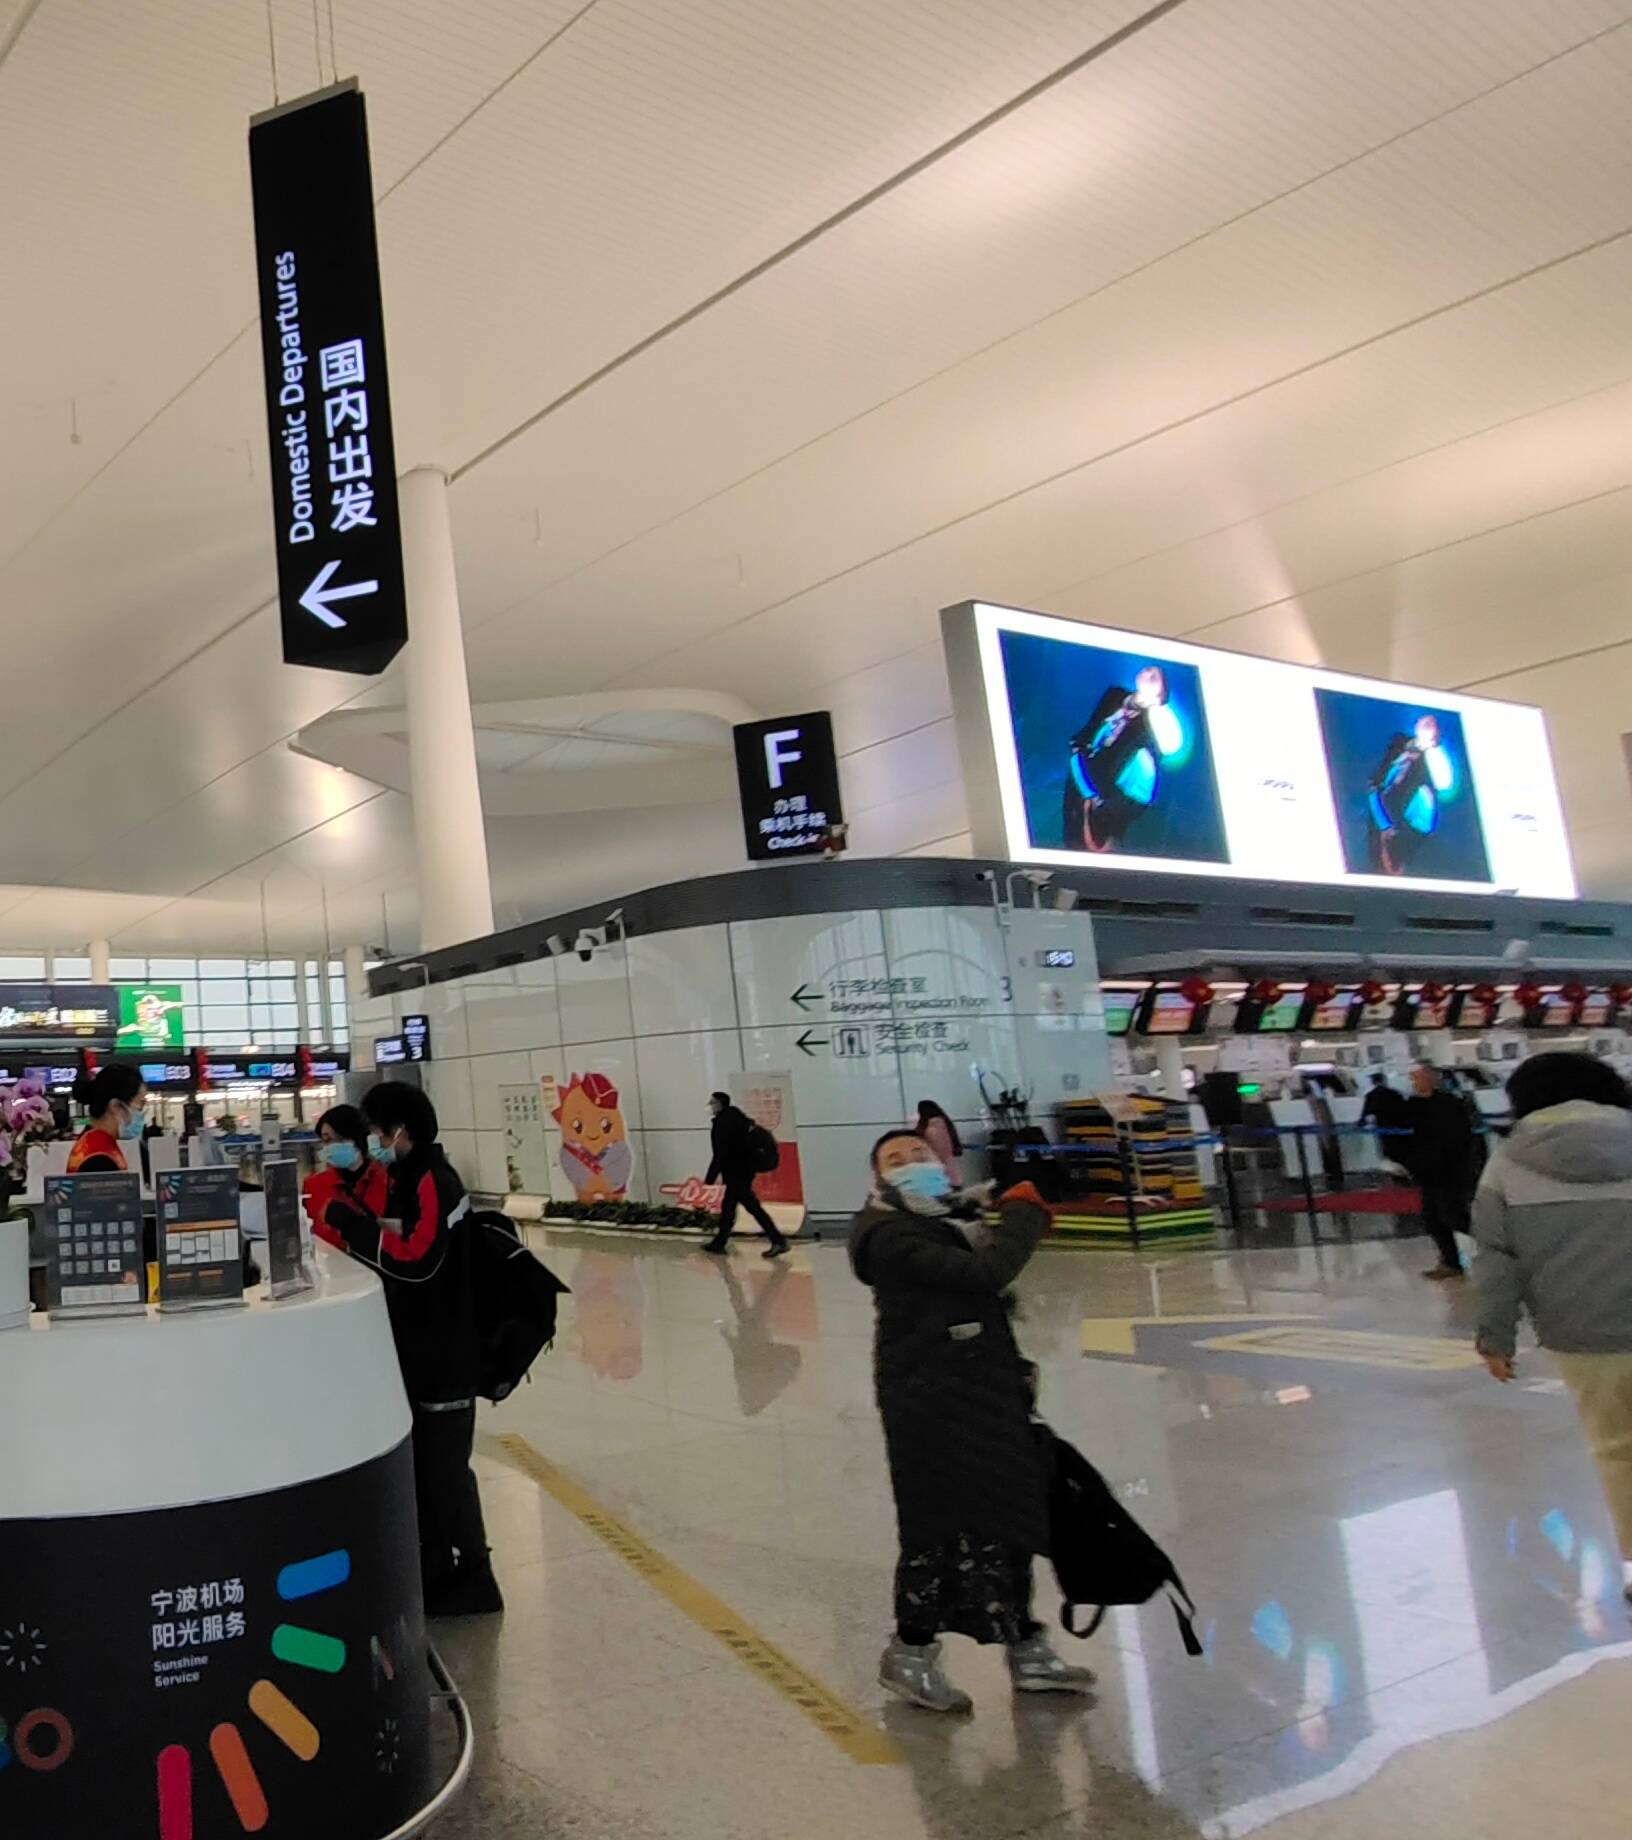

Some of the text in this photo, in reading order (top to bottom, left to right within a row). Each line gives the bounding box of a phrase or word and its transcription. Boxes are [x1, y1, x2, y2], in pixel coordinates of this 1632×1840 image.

[275, 250, 315, 543] Domestic Departures
[319, 338, 378, 533] 国内出发
[763, 728, 802, 789] F
[829, 976, 927, 998] 行李检查室
[874, 1021, 951, 1041] 安全检查
[875, 1040, 971, 1056] Security Check
[151, 1577, 245, 1617] 宁波机场
[152, 1611, 247, 1652] 阳光服务
[153, 1655, 209, 1673] Sunshine
[154, 1671, 201, 1688] Service
